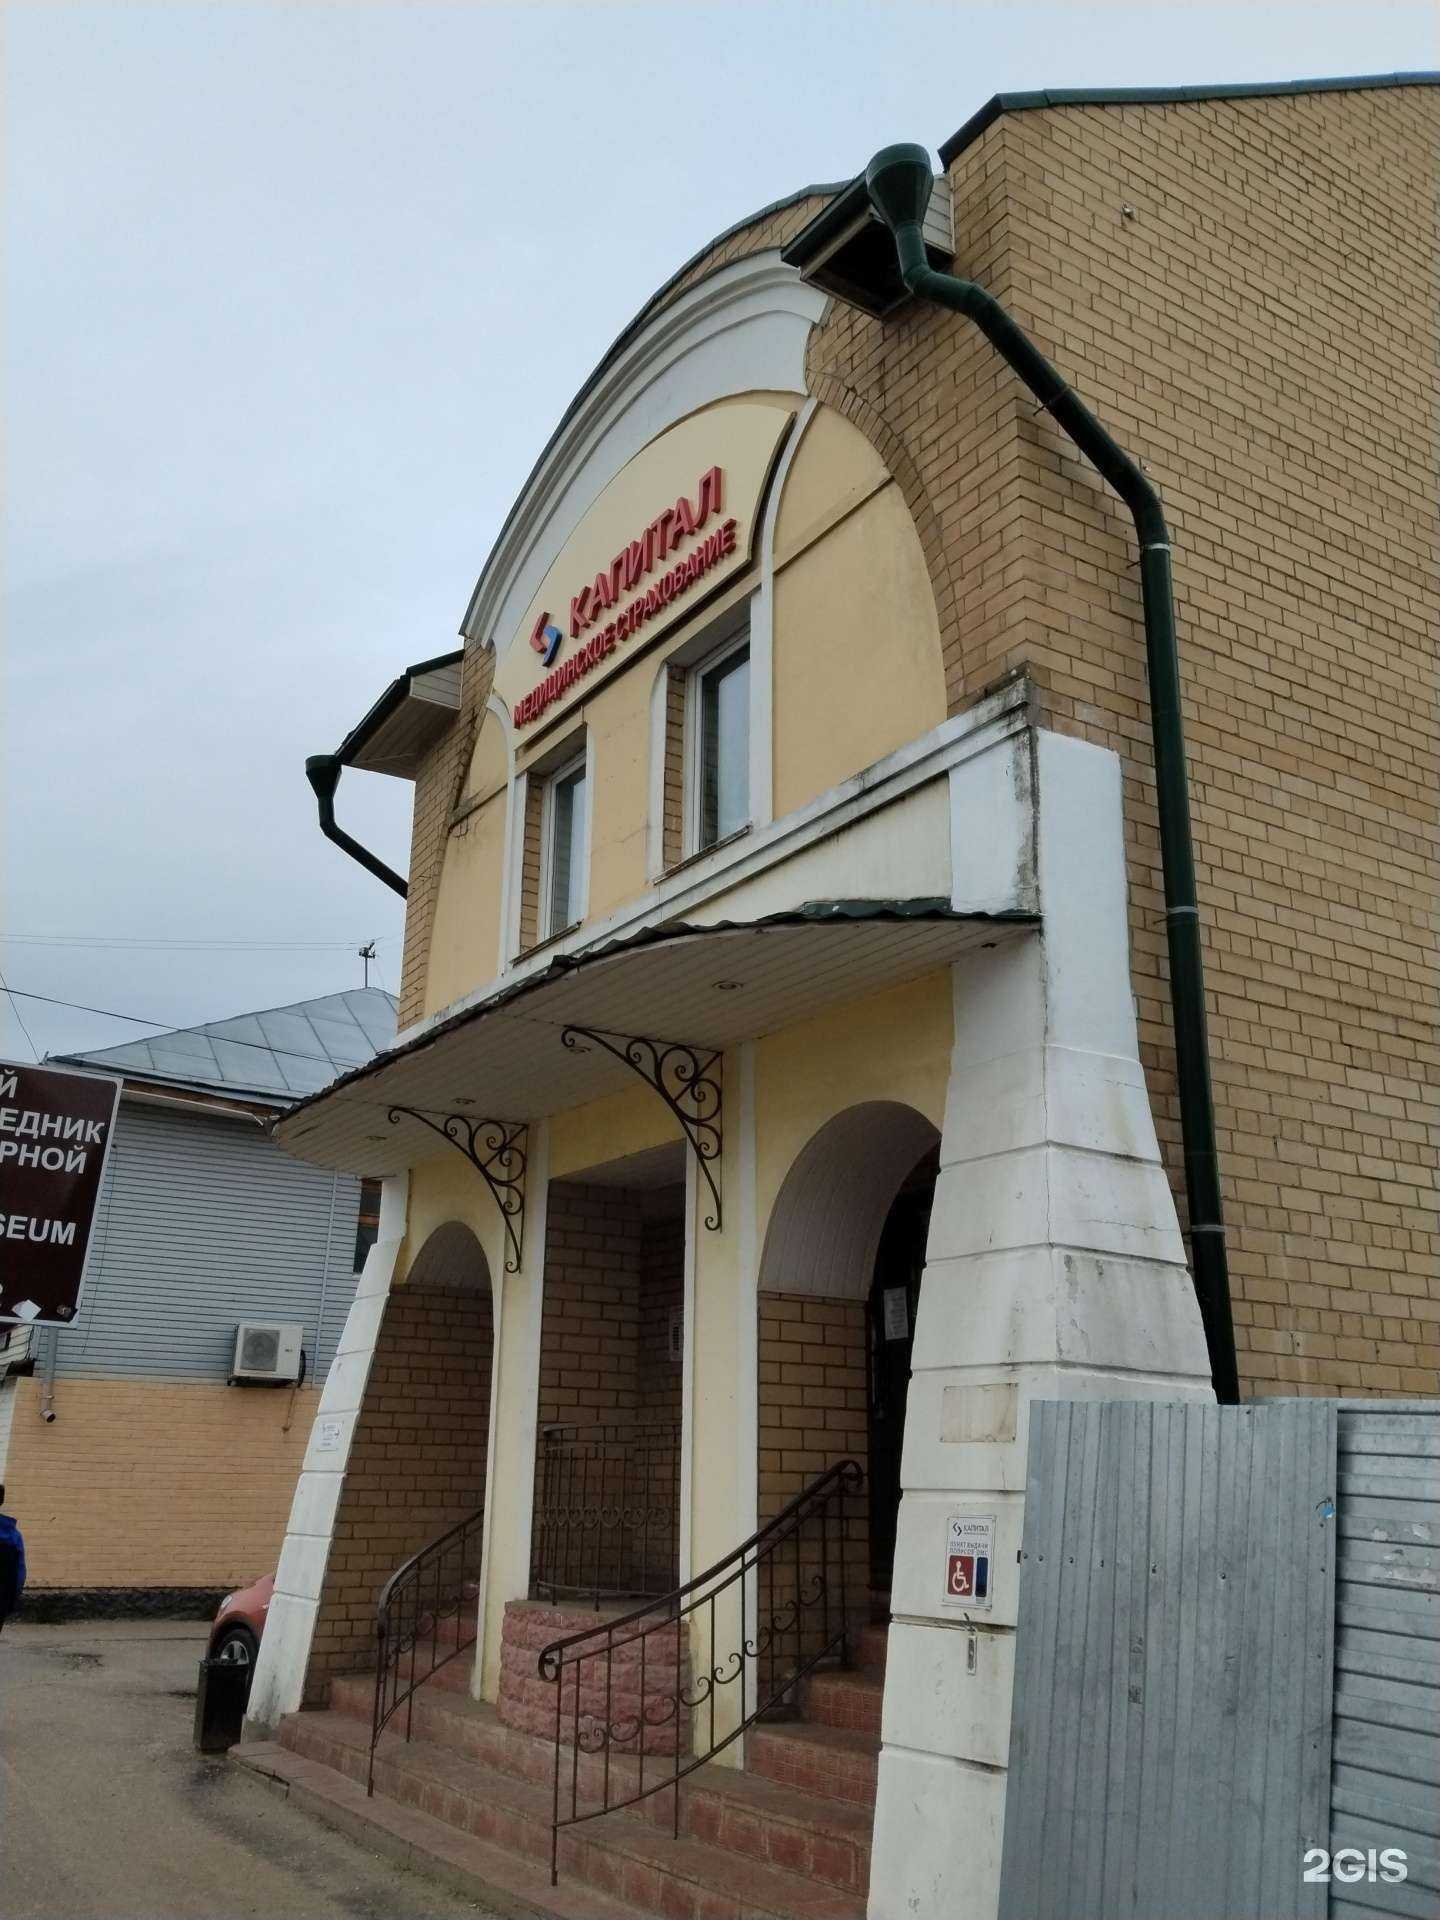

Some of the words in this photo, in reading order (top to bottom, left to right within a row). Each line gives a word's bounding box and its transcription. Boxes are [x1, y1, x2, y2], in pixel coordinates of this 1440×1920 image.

[569, 465, 722, 639] КАПИТАЛ
[513, 622, 616, 730] МЕДИЦИНСКОЕ
[614, 518, 737, 642] СТРАХОВАНИЕ
[0, 1107, 105, 1144] ЕДНИК
[0, 1141, 88, 1174] РНОЙ
